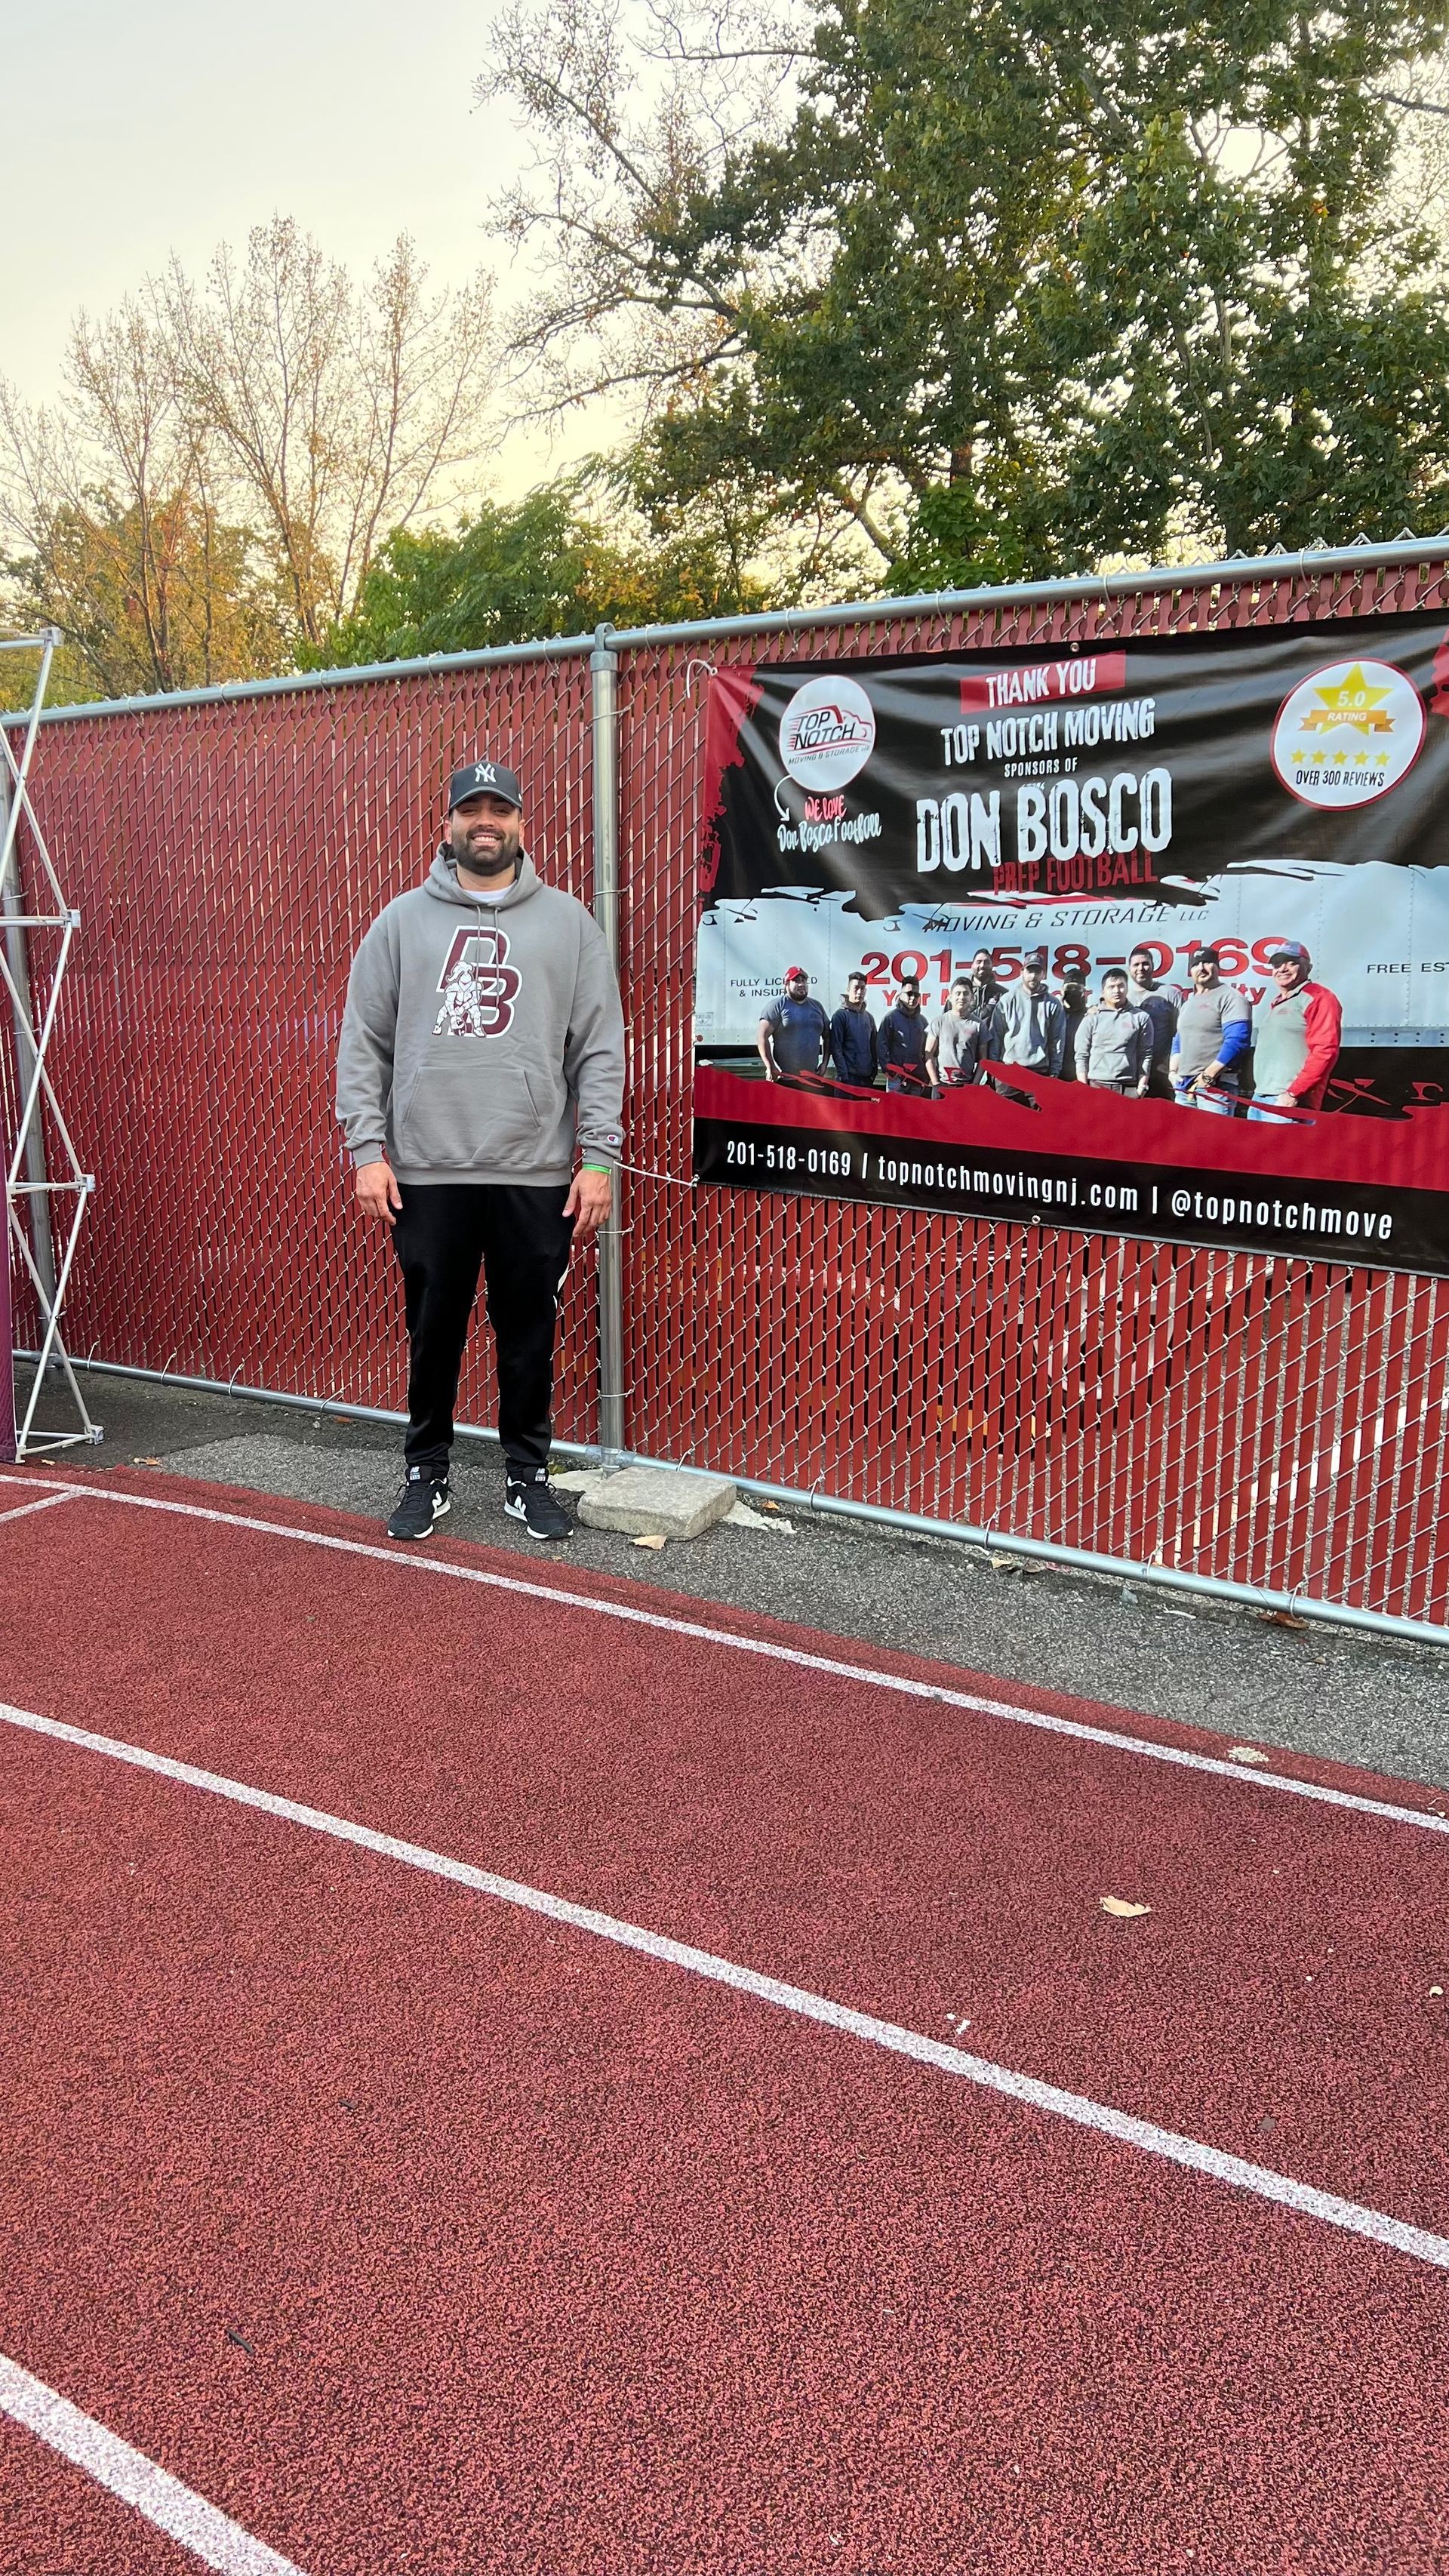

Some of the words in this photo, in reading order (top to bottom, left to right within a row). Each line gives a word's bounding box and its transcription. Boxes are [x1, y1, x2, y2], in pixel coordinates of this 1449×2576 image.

[986, 666, 1050, 708] THANK
[1056, 658, 1097, 694] YOU
[1337, 691, 1366, 706] 5.0
[793, 711, 831, 732] TOP
[1327, 712, 1367, 722] RATING
[792, 722, 856, 750] NOTCH
[940, 724, 980, 766] TOP
[986, 711, 1059, 760] NOTCH
[1064, 697, 1156, 747] MOVING
[788, 753, 817, 765] MOVING
[825, 746, 859, 759] STORAGE
[1004, 758, 1060, 778] SPONSORS
[1064, 757, 1078, 772] OF
[1296, 770, 1319, 786] OVER
[1322, 770, 1340, 786] 300
[1343, 771, 1385, 786] REVIEWS
[916, 789, 1001, 872] DON
[1017, 768, 1173, 862] BOSCO
[777, 824, 799, 852] Don
[993, 860, 1040, 895] PREP
[1047, 850, 1158, 892] FOOTBALL
[1025, 912, 1043, 929] &
[1051, 905, 1179, 928] STORAGE
[1179, 910, 1209, 922] LLC
[1367, 963, 1411, 974] FREE
[731, 978, 760, 987] FULLY
[727, 1140, 851, 1176] 201-518-0169
[878, 1156, 1137, 1211] topnotchmovingnj.com
[1171, 1190, 1392, 1240] @topnotchmove
